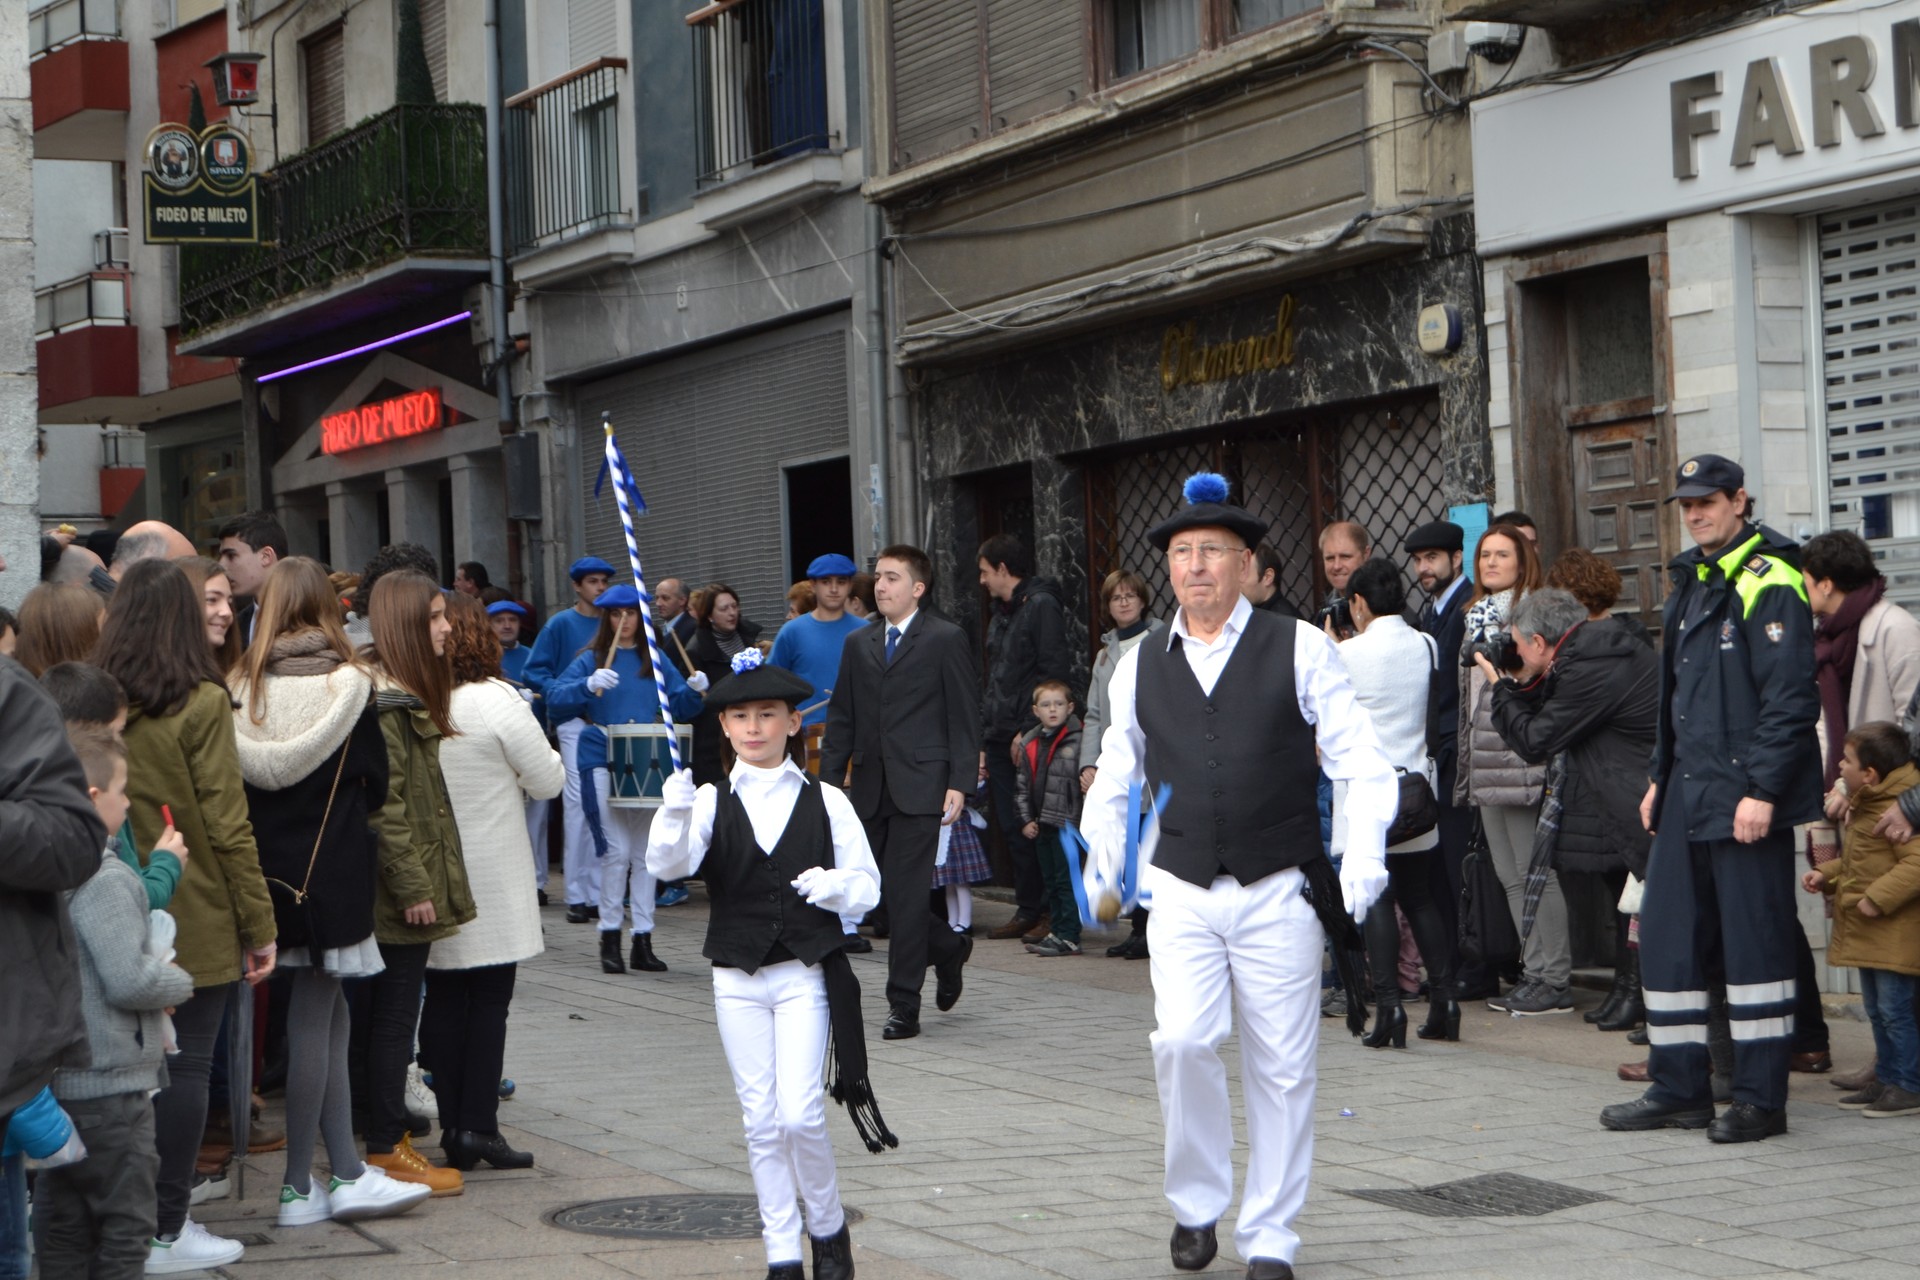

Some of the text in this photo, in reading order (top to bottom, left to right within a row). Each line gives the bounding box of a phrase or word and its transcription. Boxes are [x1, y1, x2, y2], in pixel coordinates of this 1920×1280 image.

[155, 207, 248, 223] FIDEO DE MILETO
